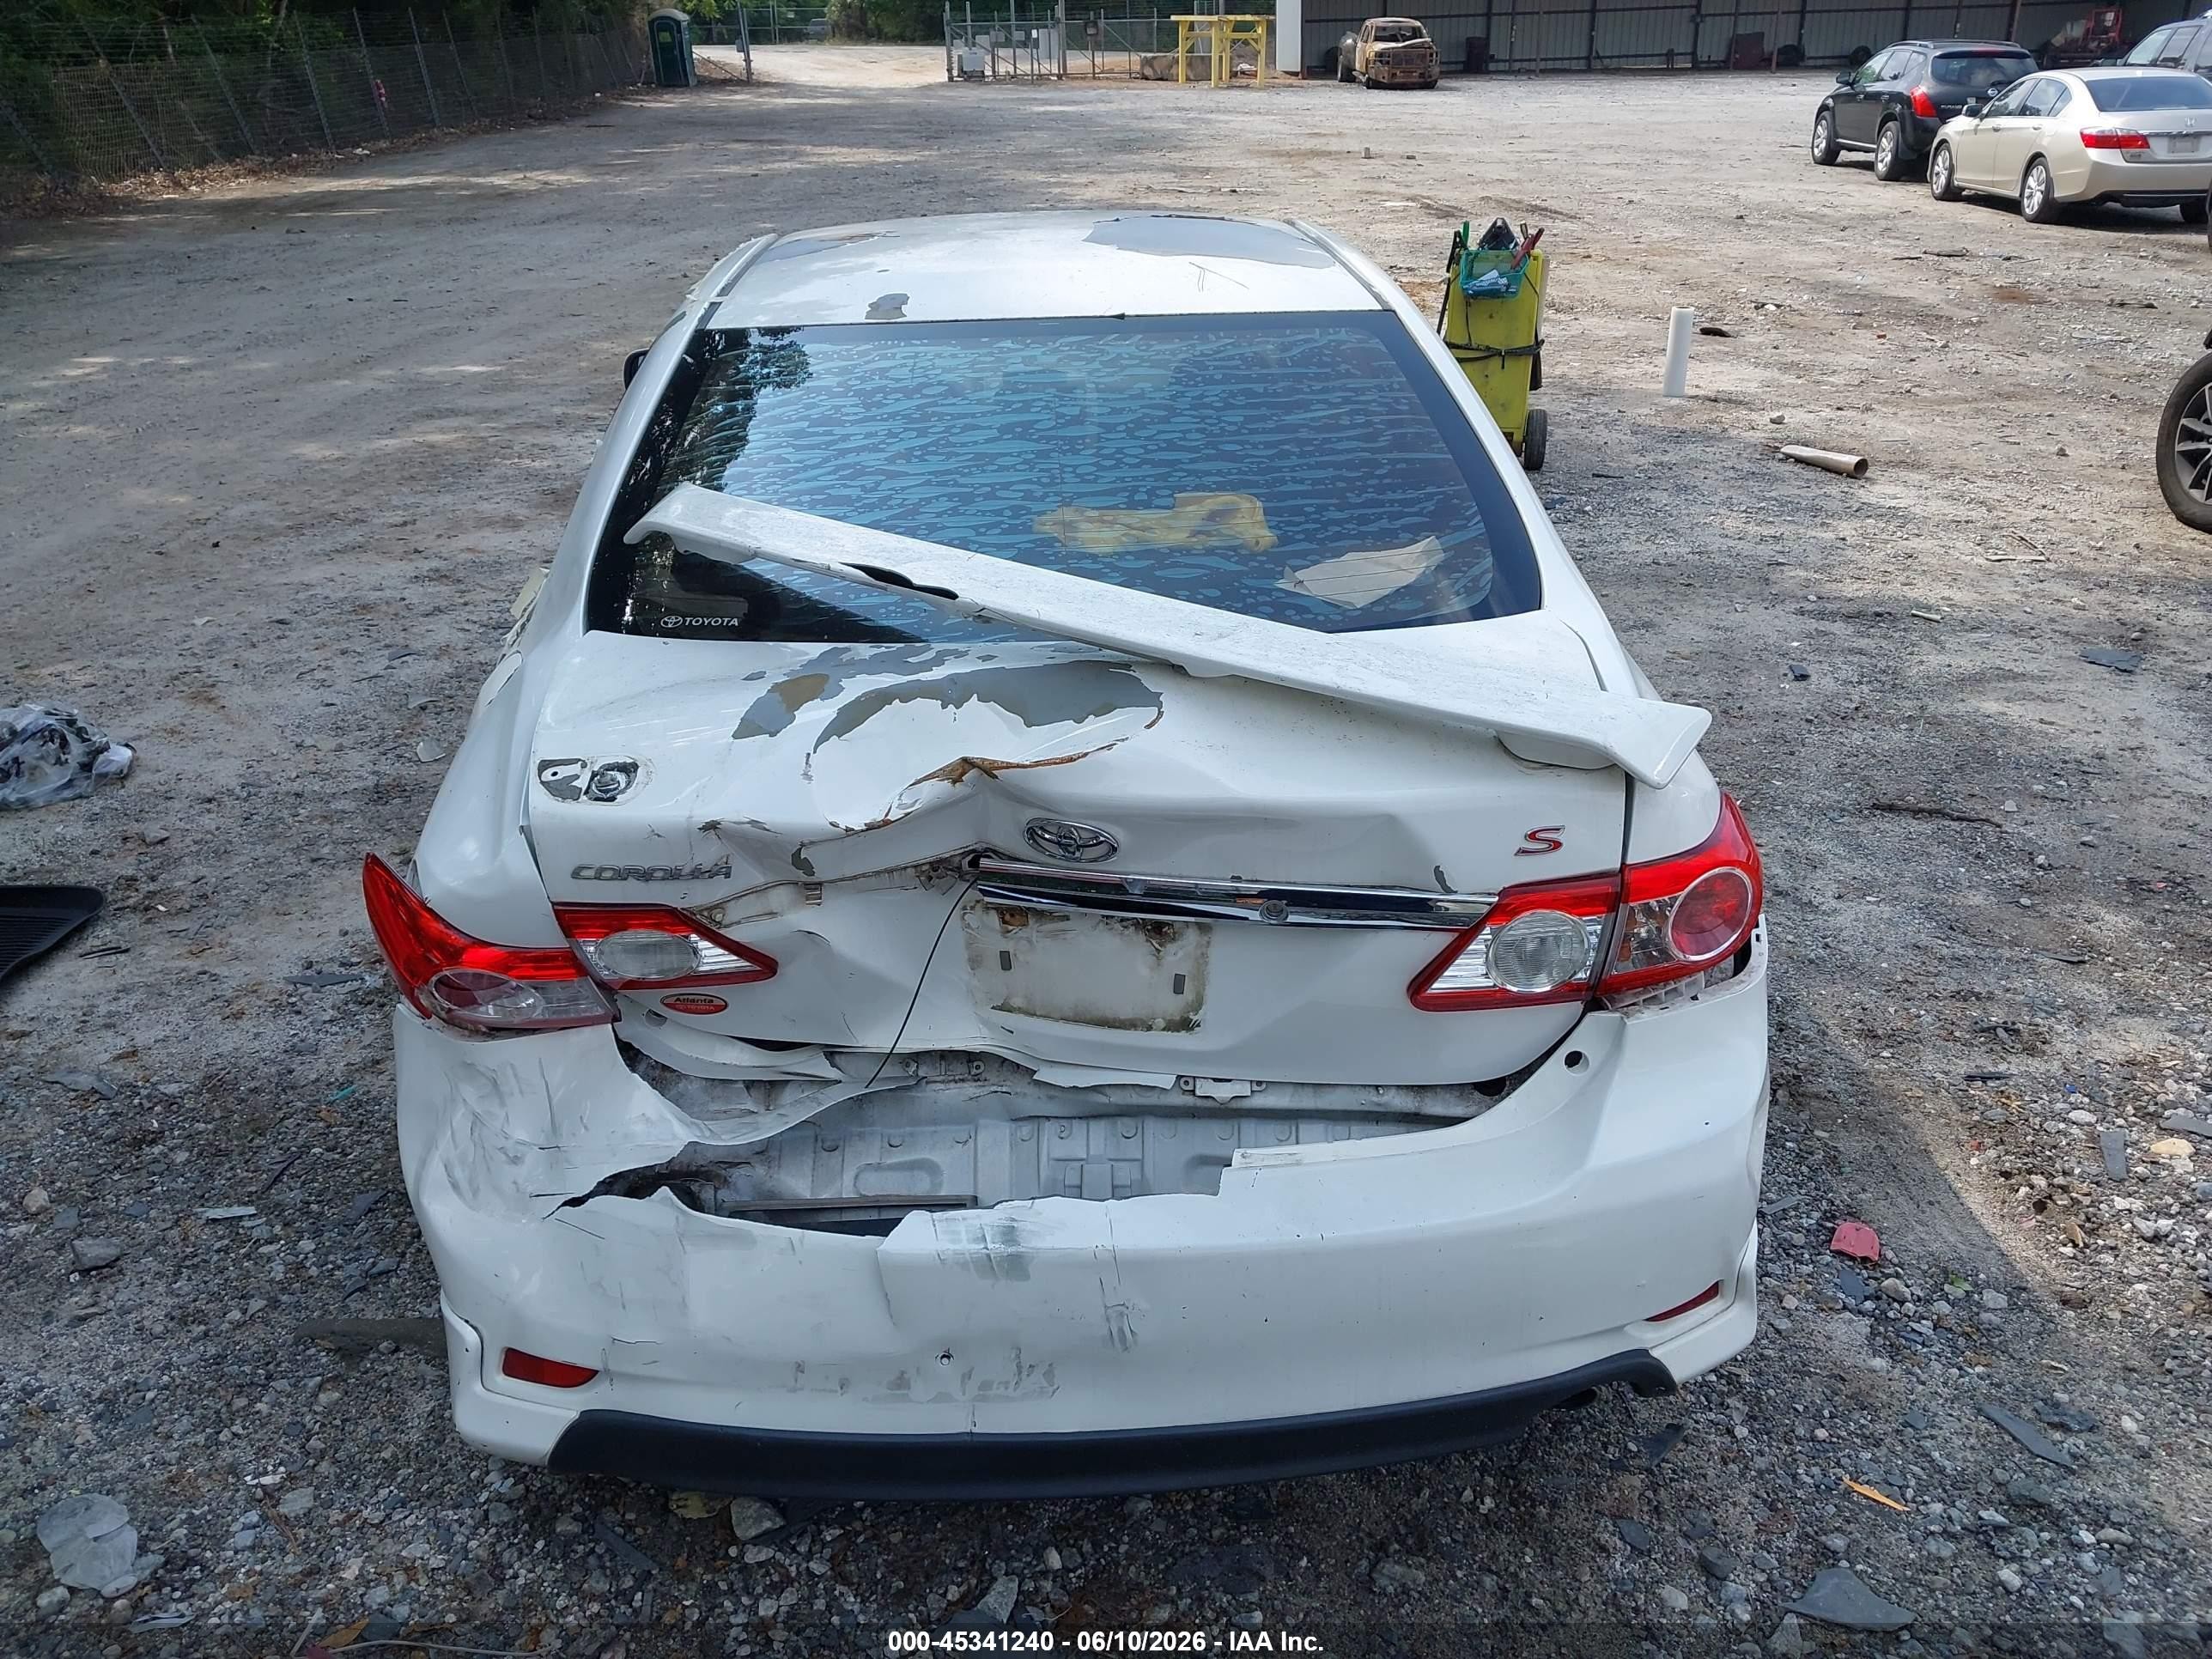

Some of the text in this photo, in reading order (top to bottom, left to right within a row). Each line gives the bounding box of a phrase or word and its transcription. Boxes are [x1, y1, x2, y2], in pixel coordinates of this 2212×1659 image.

[684, 617, 738, 626] TOYOTA
[1514, 825, 1565, 856] S
[570, 863, 732, 883] COROLLA
